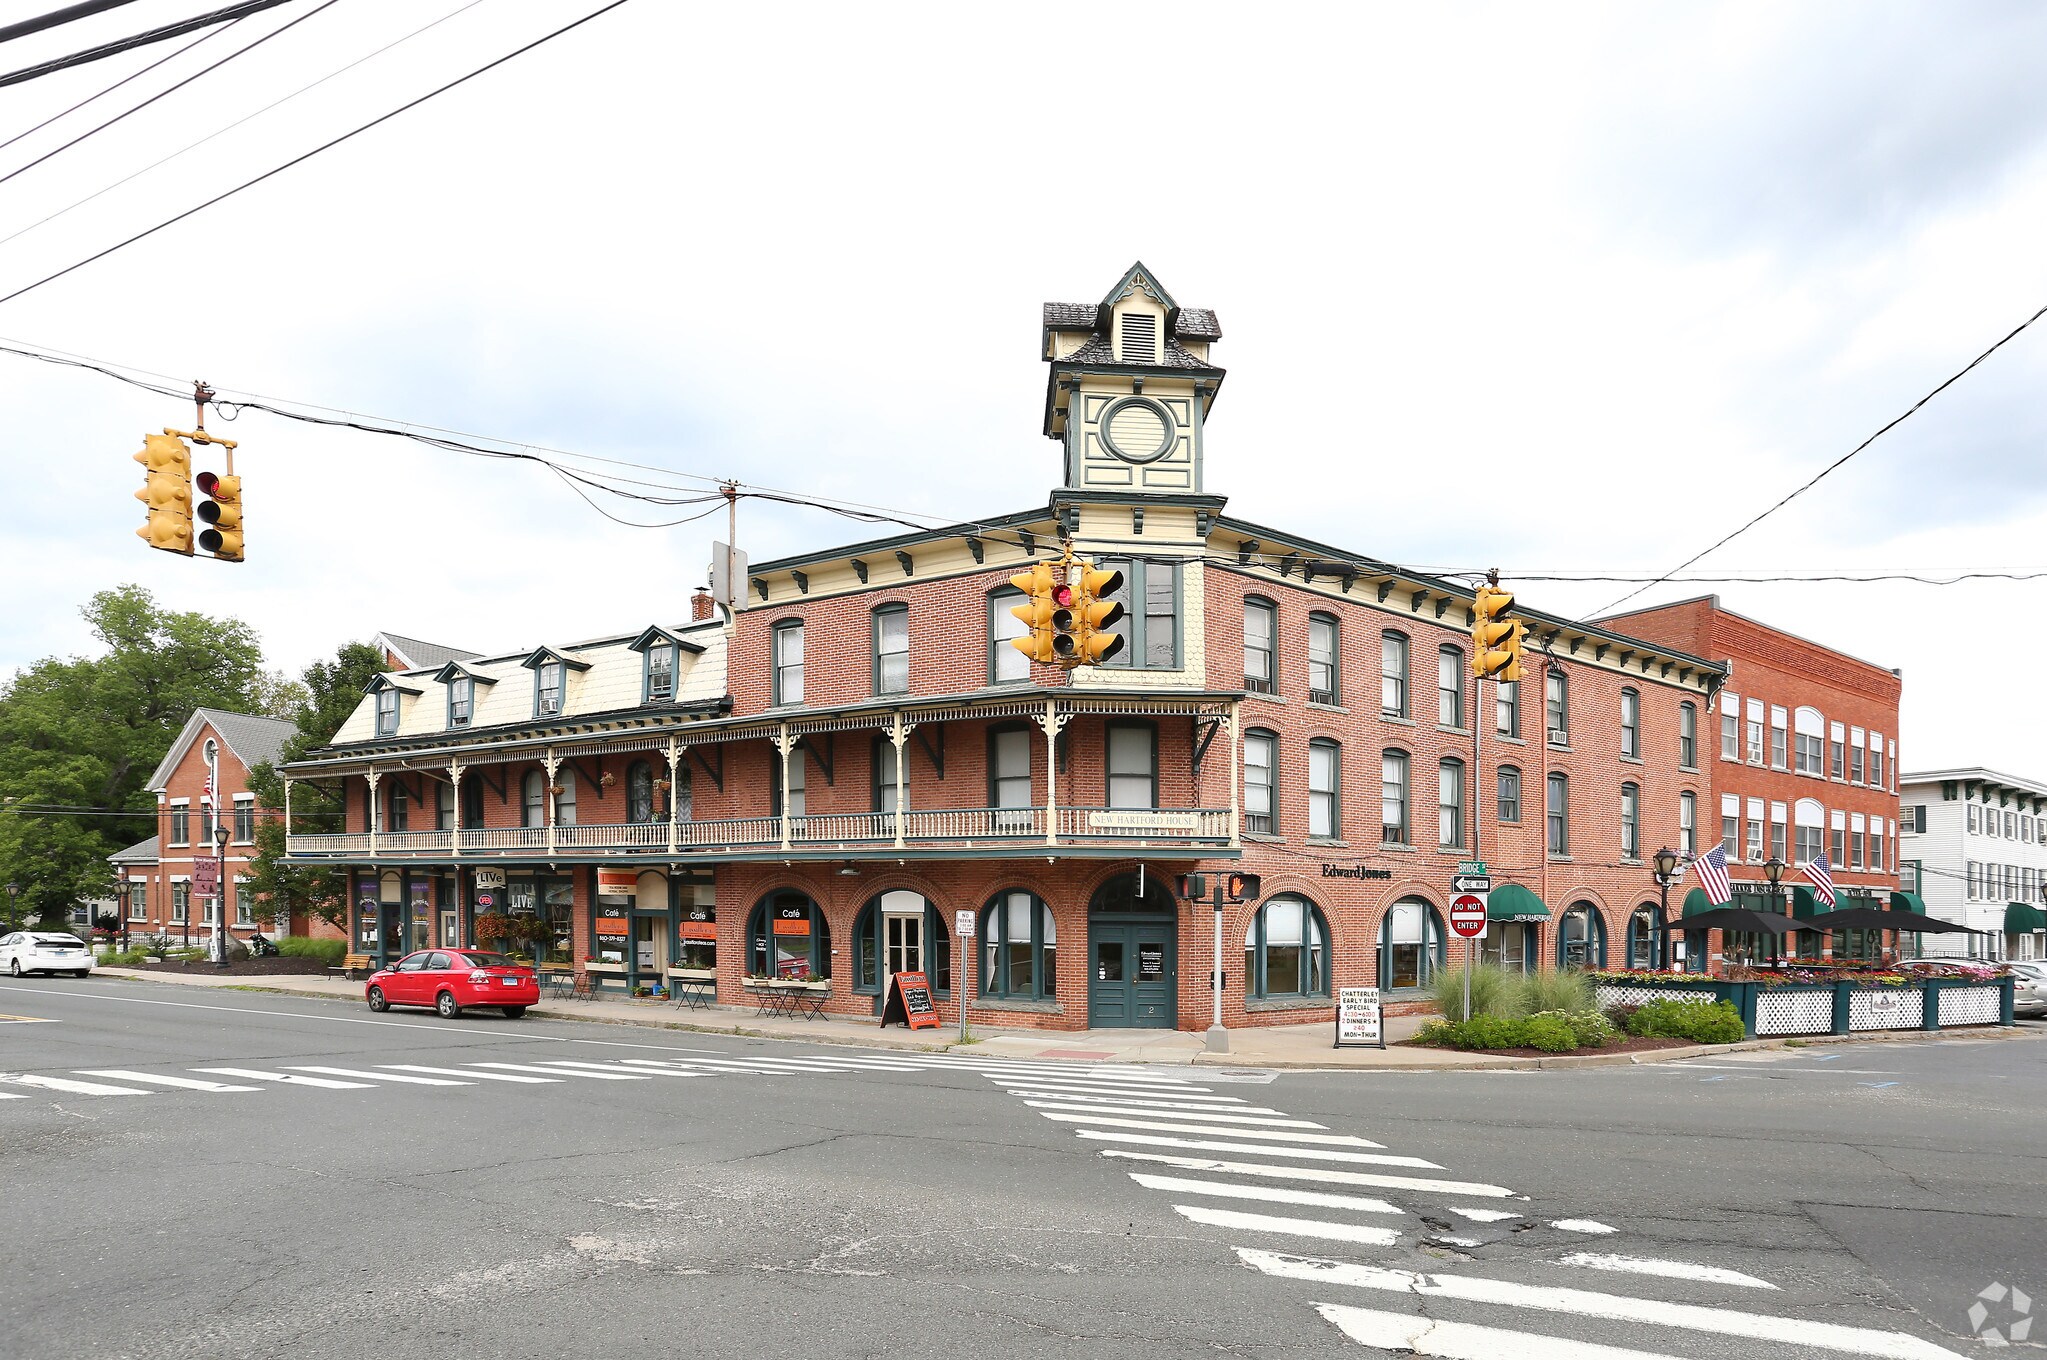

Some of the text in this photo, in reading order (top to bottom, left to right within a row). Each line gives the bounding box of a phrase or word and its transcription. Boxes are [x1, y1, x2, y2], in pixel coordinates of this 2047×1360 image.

[1094, 815, 1194, 825] NEW HARTFORD HOUSE
[1459, 863, 1480, 873] BRIDGE
[605, 908, 619, 917] Café
[690, 911, 706, 920] Café
[782, 909, 801, 918] Café
[1148, 1006, 1154, 1014] 2
